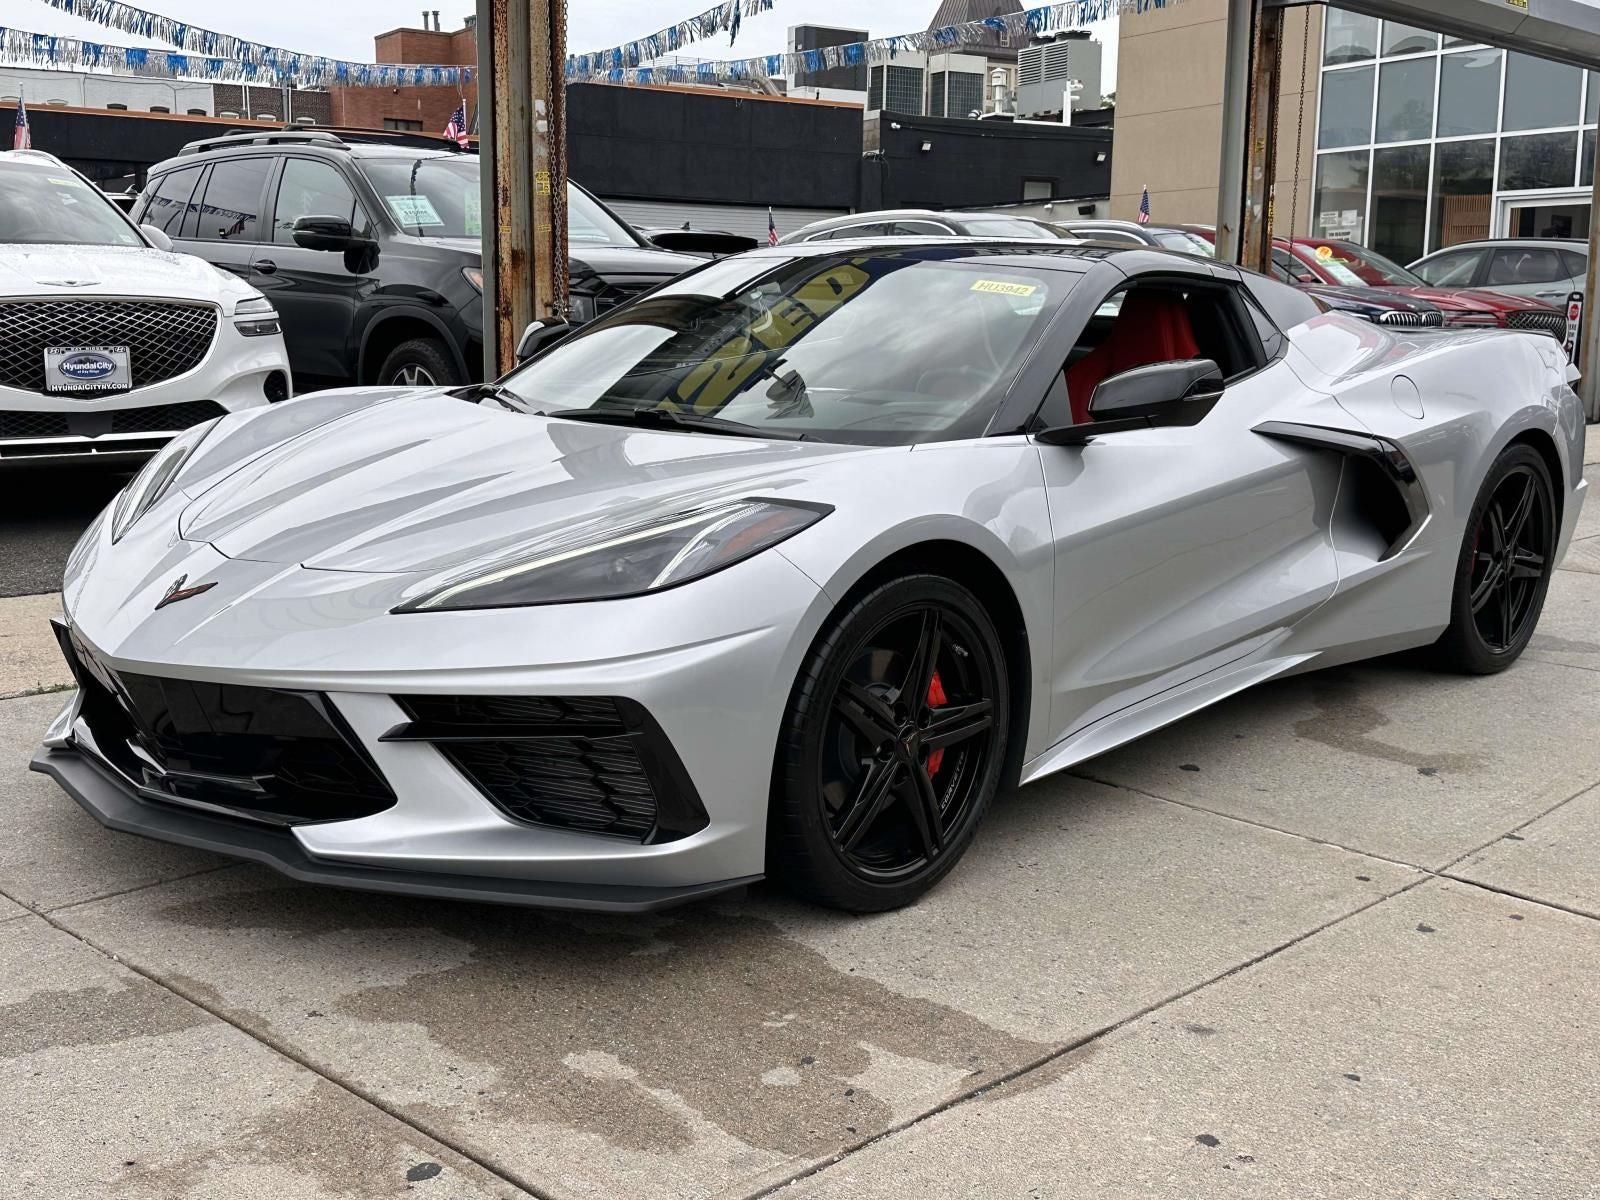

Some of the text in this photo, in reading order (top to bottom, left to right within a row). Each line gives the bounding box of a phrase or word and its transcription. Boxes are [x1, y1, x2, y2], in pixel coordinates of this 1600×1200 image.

[976, 281, 1029, 295] HU3942
[63, 361, 112, 371] Hyundai City
